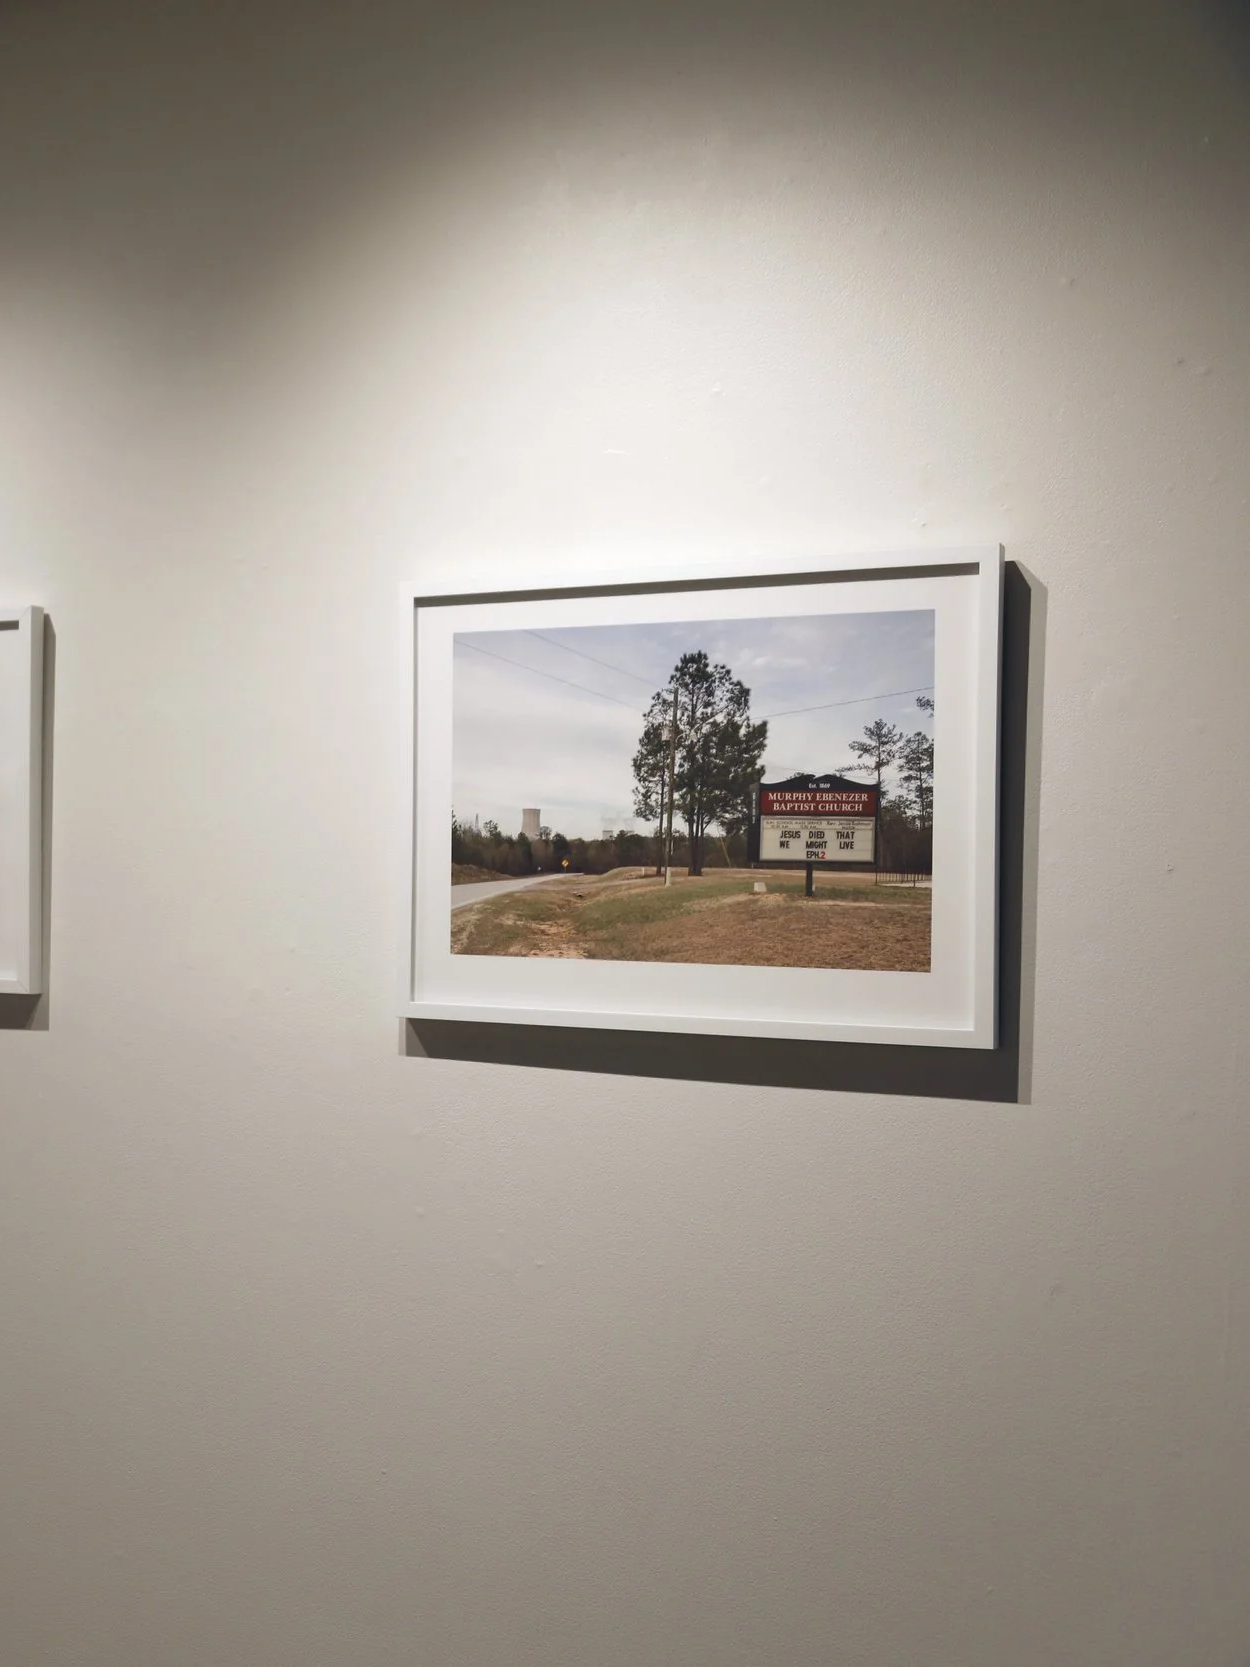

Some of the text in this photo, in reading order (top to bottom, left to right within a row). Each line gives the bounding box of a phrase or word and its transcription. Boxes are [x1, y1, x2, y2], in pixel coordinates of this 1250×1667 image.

[768, 792, 868, 801] MURPHY EBENEZER
[773, 802, 863, 812] BAPTIST CHURCH
[780, 830, 855, 840] JESUS DIED THAT
[779, 840, 855, 849] WE MIGHT LIVE
